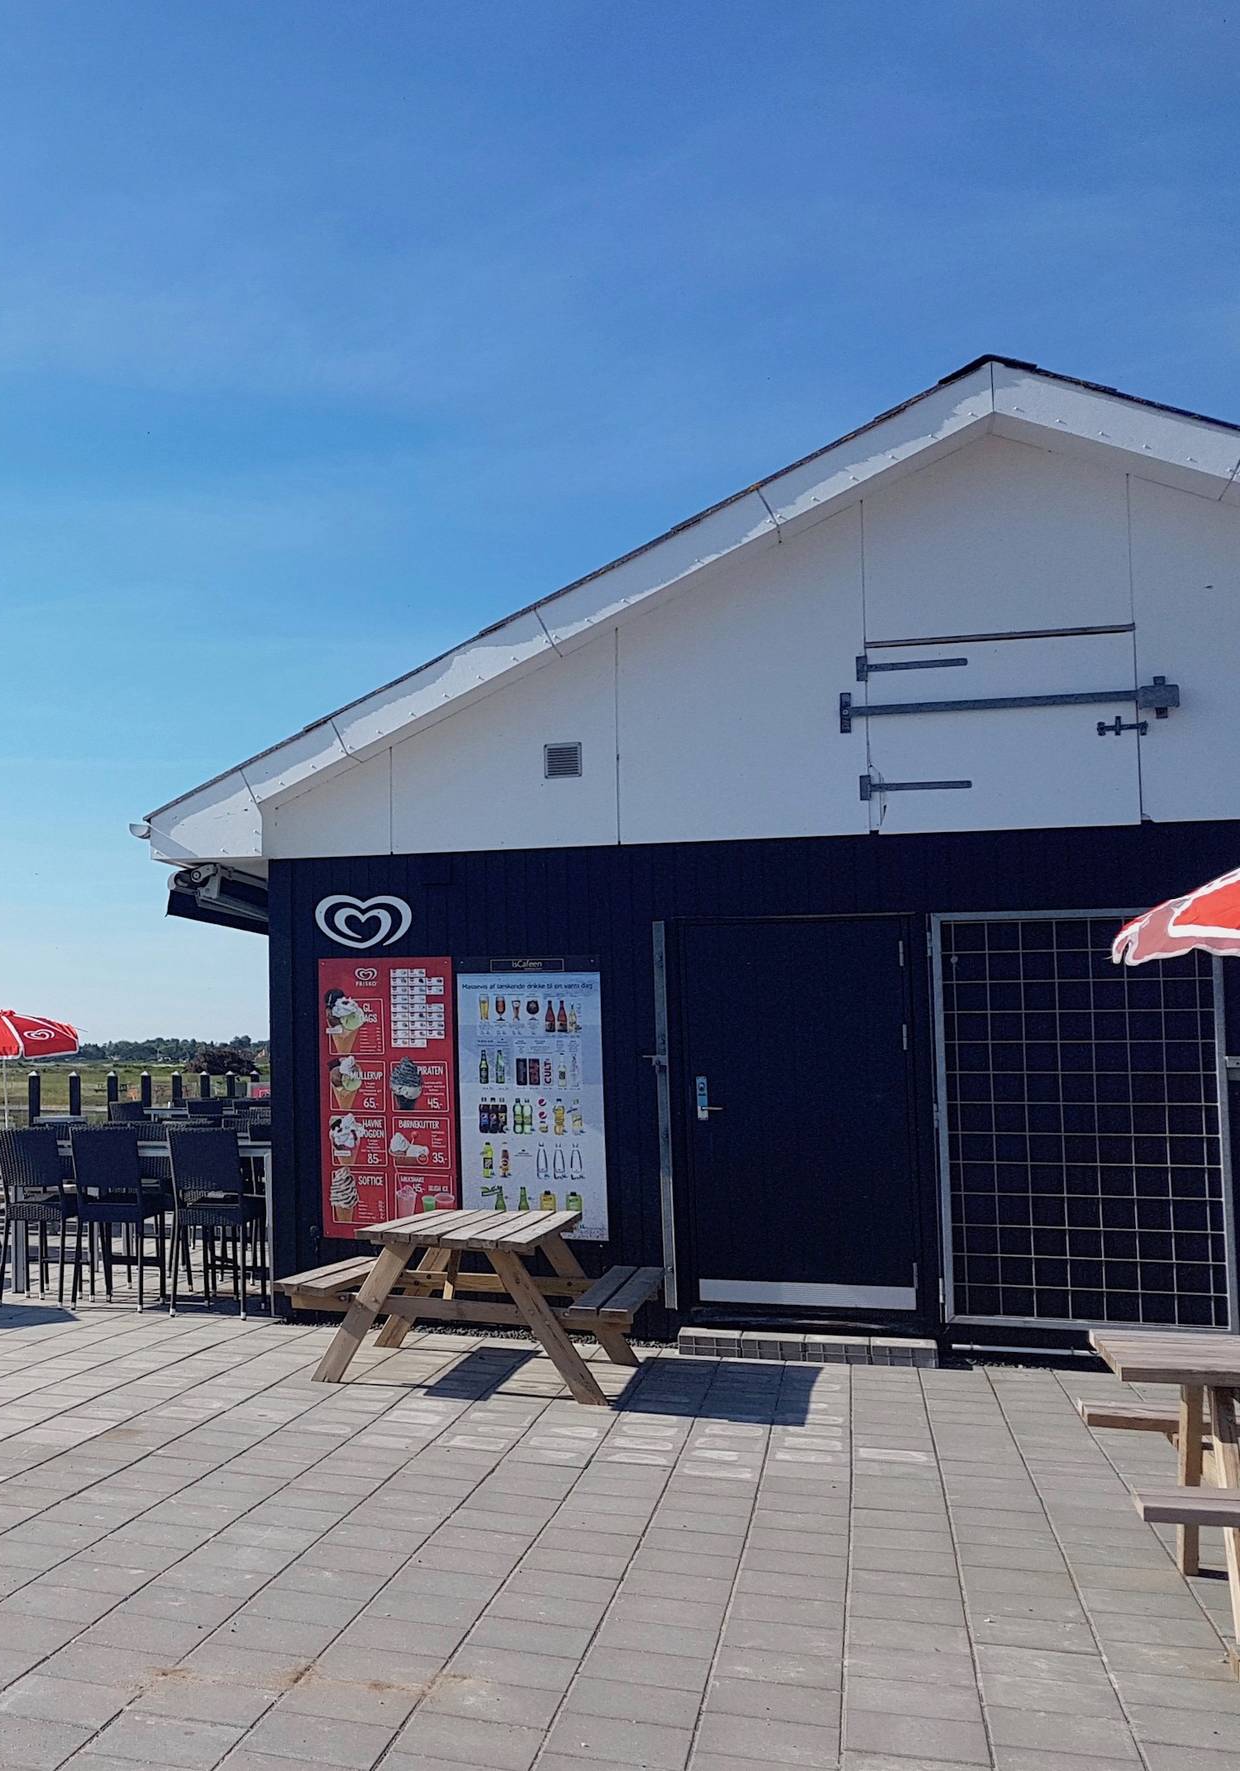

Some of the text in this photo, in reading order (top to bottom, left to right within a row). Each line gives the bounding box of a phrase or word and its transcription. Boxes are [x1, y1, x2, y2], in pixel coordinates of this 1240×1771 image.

[580, 983, 593, 991] dag
[418, 1066, 443, 1075] PIRATEN
[362, 1119, 383, 1128] HAVNE
[358, 1175, 384, 1186] SOFTICE
